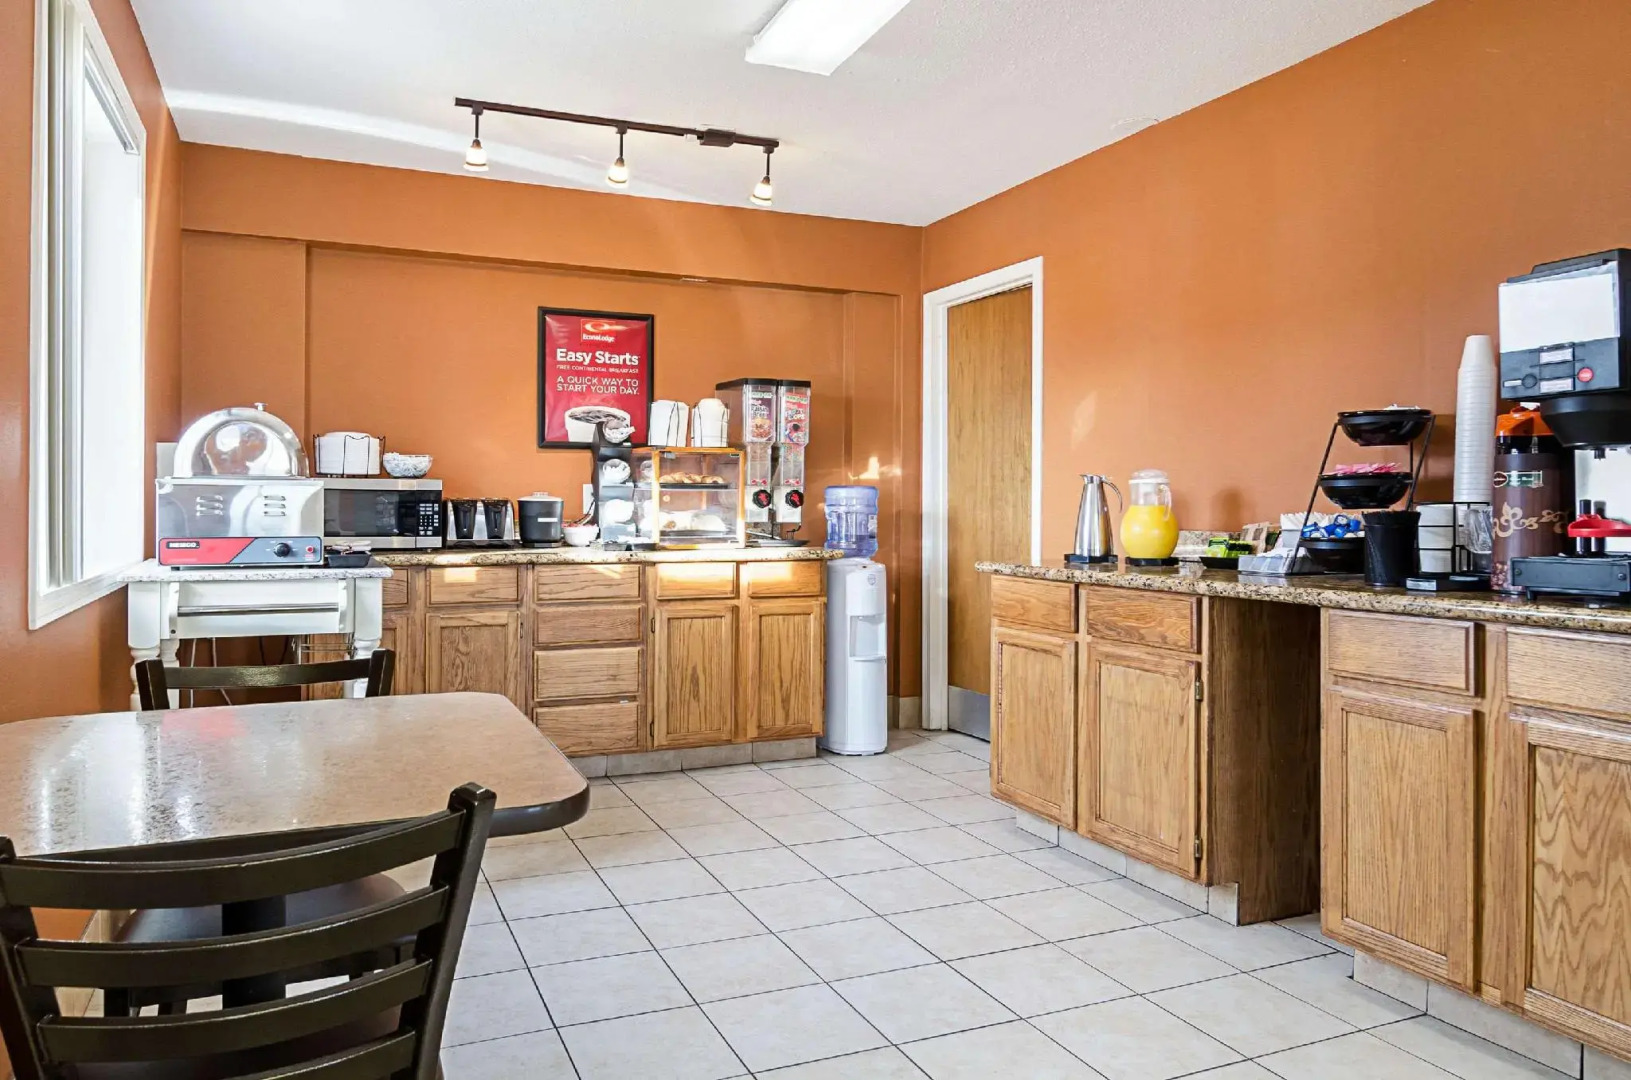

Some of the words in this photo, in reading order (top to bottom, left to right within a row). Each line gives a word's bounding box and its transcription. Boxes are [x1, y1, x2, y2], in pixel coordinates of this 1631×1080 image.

[556, 348, 592, 365] Easy
[595, 350, 639, 366] Starts
[557, 375, 564, 383] A
[567, 376, 599, 385] QUICK
[601, 377, 623, 386] WAY
[626, 379, 639, 387] TO
[556, 383, 587, 392] START
[590, 385, 617, 394] YOUR
[620, 387, 640, 395] DAY.
